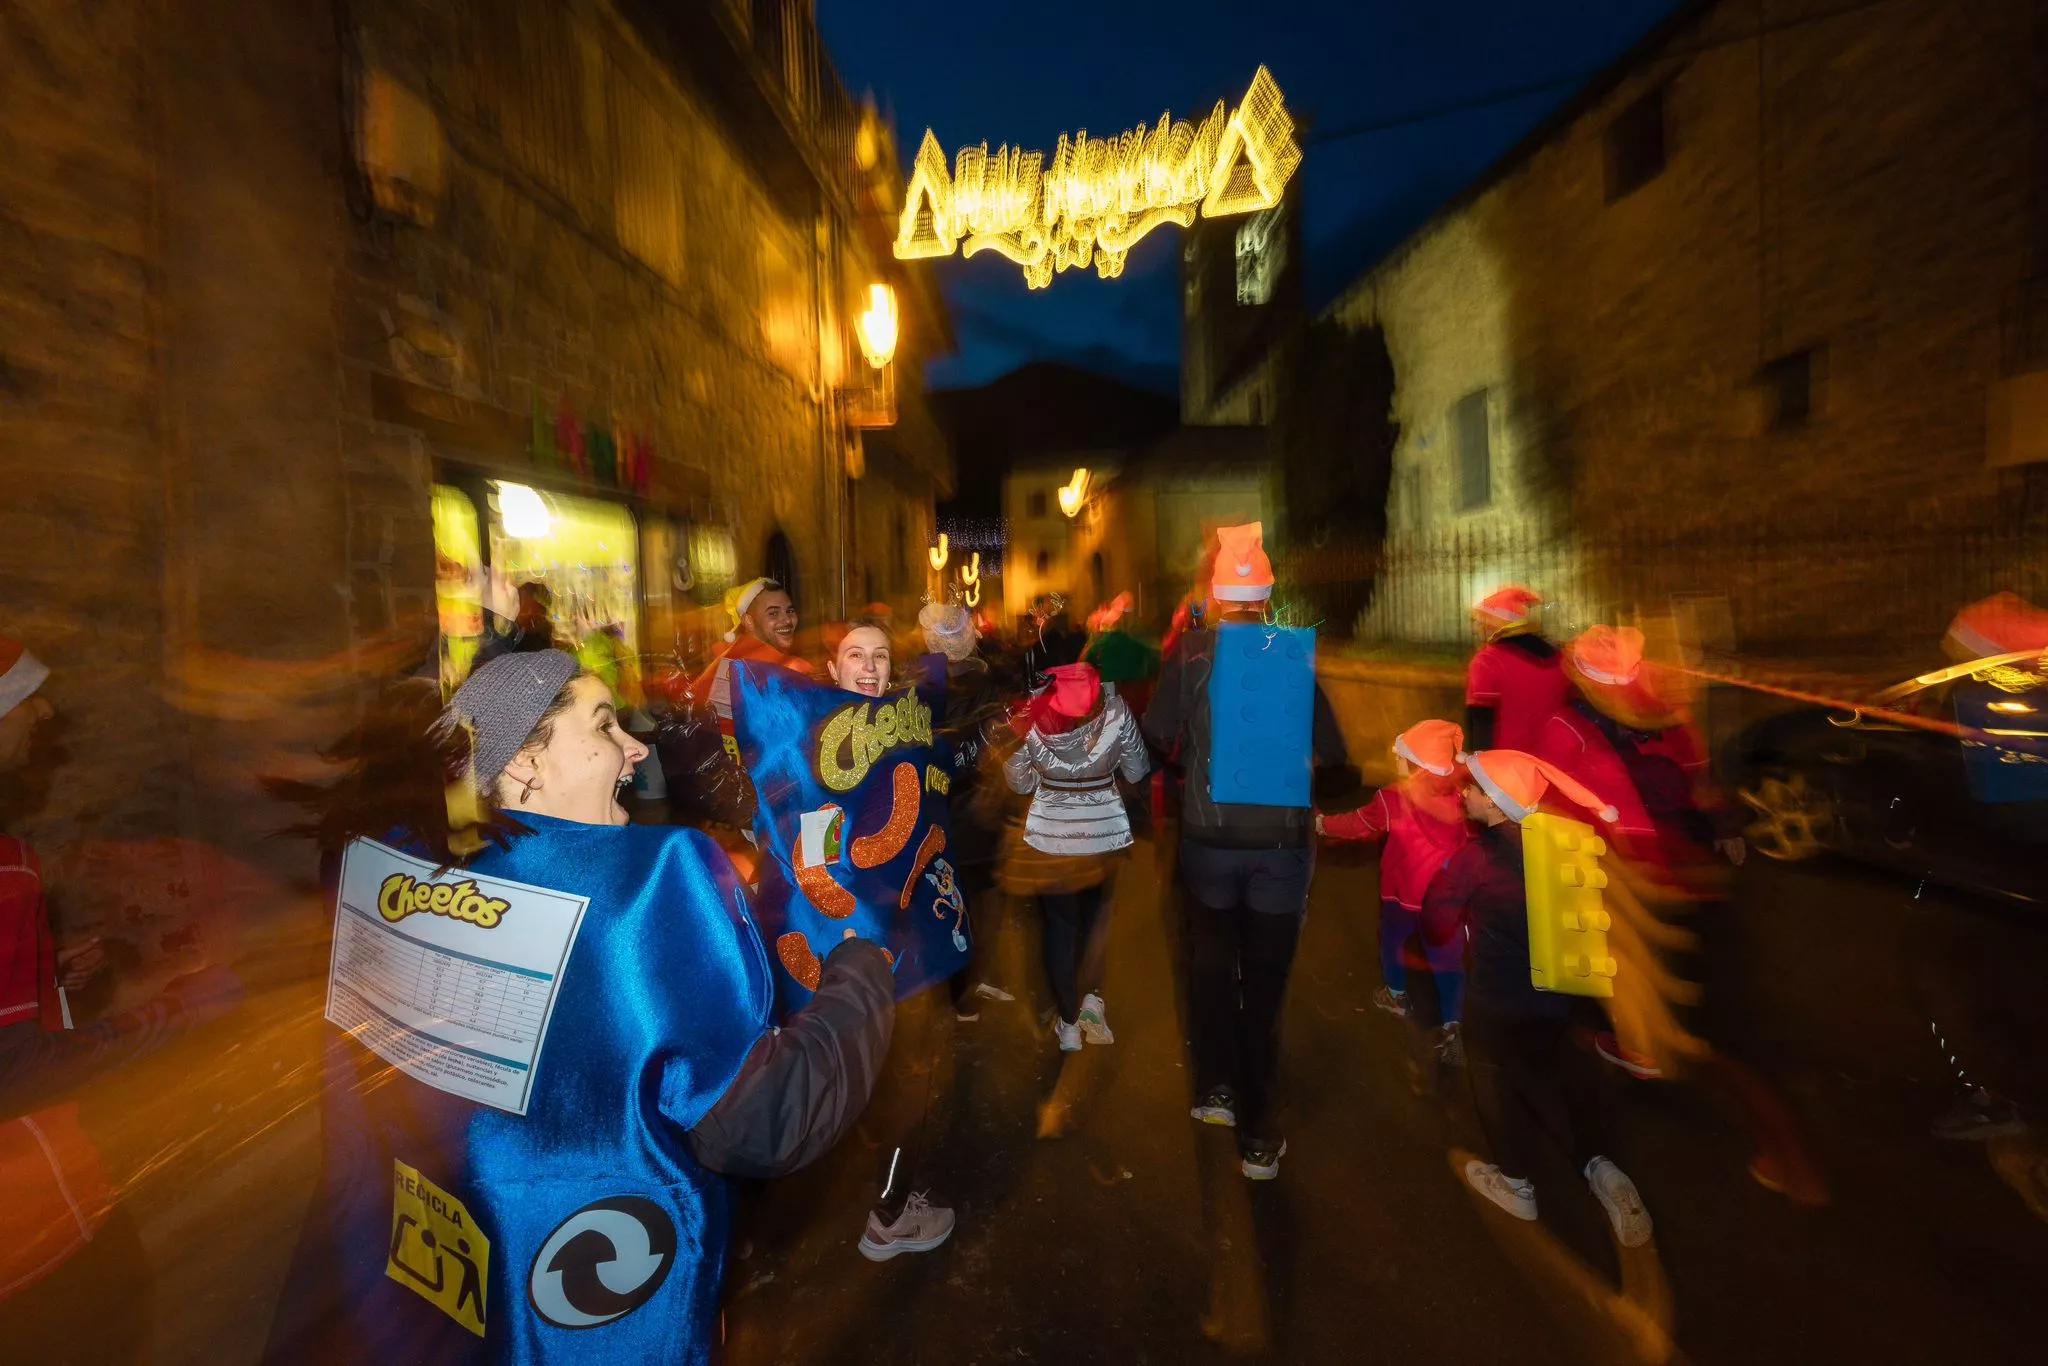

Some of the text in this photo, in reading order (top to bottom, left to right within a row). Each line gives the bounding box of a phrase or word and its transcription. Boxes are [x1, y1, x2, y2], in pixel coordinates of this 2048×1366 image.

[820, 686, 932, 791] Cheetos
[378, 873, 511, 929] Cheetos
[395, 1171, 463, 1229] RECICLA
